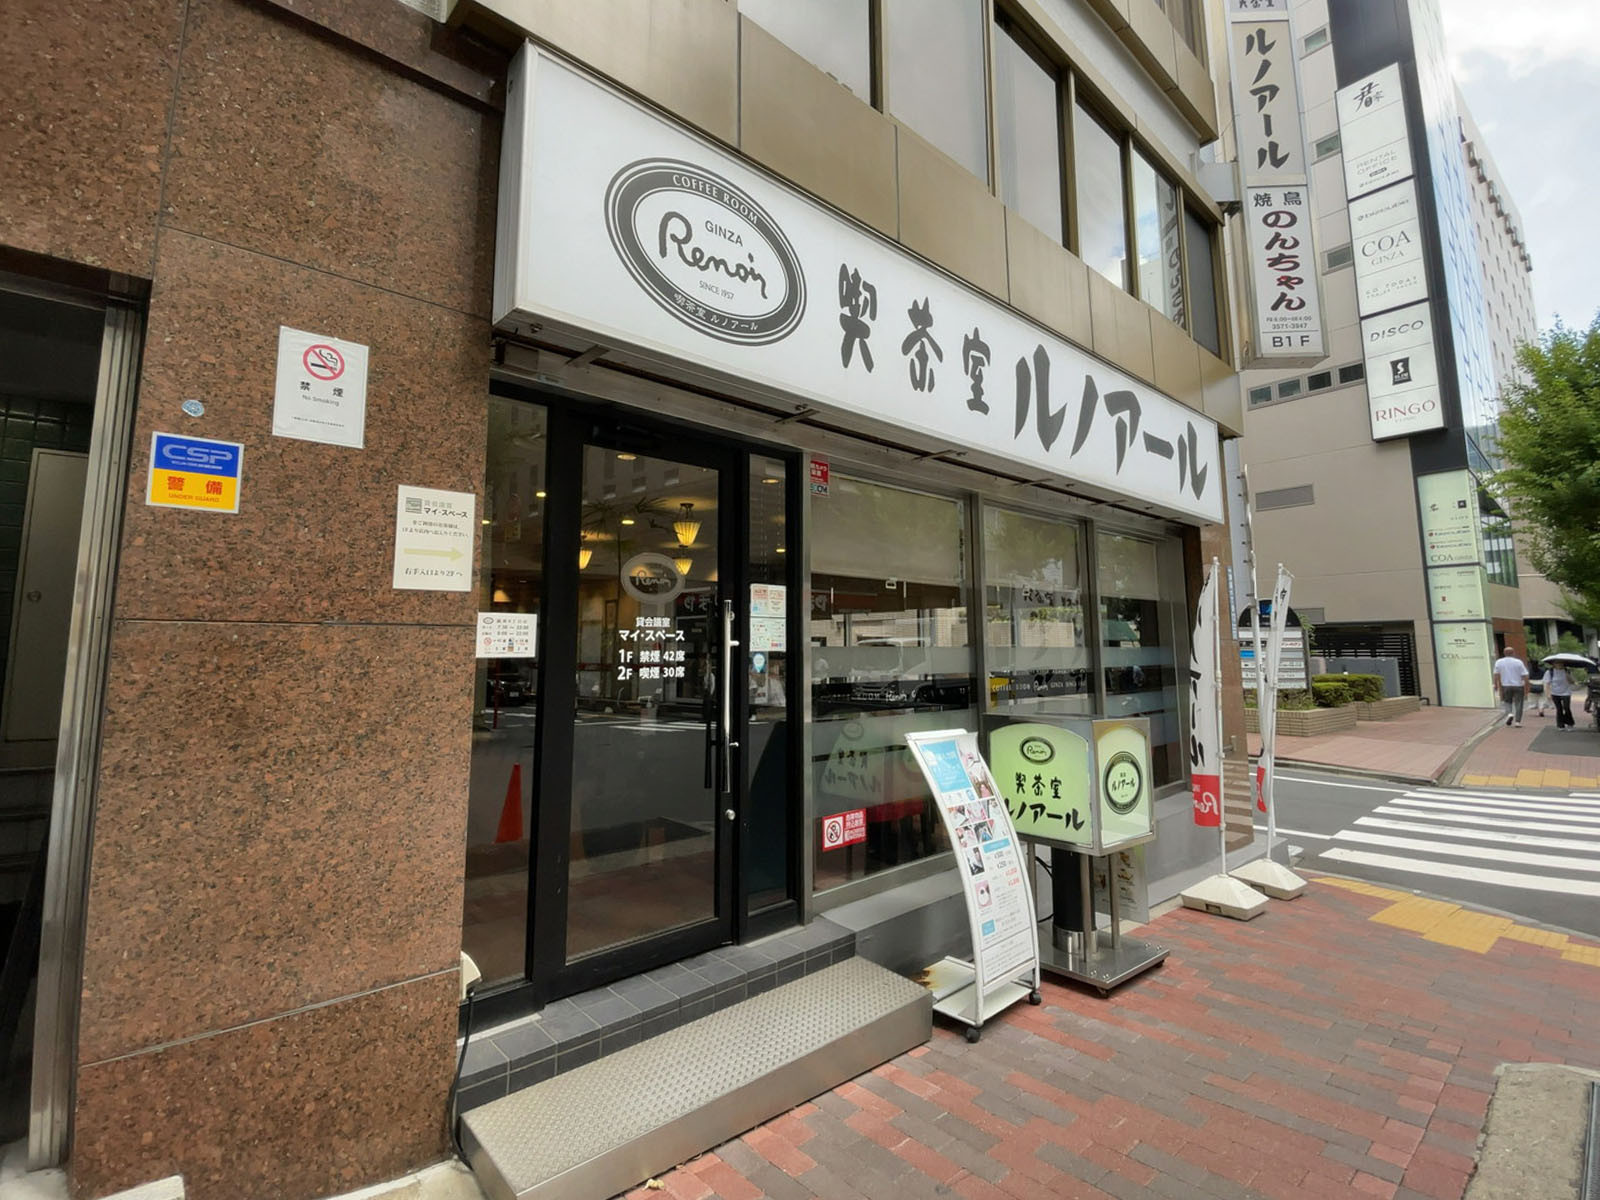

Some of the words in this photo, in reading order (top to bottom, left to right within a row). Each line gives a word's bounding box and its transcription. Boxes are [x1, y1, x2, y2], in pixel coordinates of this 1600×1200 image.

[1245, 28, 1290, 169] ルノアール
[672, 174, 718, 199] COFFEE
[723, 191, 758, 225] ROOM
[1253, 192, 1302, 208] 焼鳥
[704, 219, 744, 248] GINZA
[1361, 229, 1412, 258] COA
[658, 210, 768, 300] Renoir
[1261, 210, 1306, 312] のんちゃん
[698, 280, 720, 296] SINCE
[720, 286, 735, 301] 1957
[709, 313, 759, 332] ルノアール
[1370, 319, 1424, 342] DISCO
[300, 381, 344, 398] 禁煙
[1375, 399, 1436, 422] RINGO
[162, 443, 233, 464] CSP
[167, 475, 223, 496] 警備
[618, 630, 686, 642] マイ・スペース
[618, 648, 634, 663] 1F
[639, 650, 661, 663] 禁煙
[617, 665, 634, 681] 2F
[639, 666, 661, 680] 喫煙
[1015, 772, 1062, 800] 喫茶室
